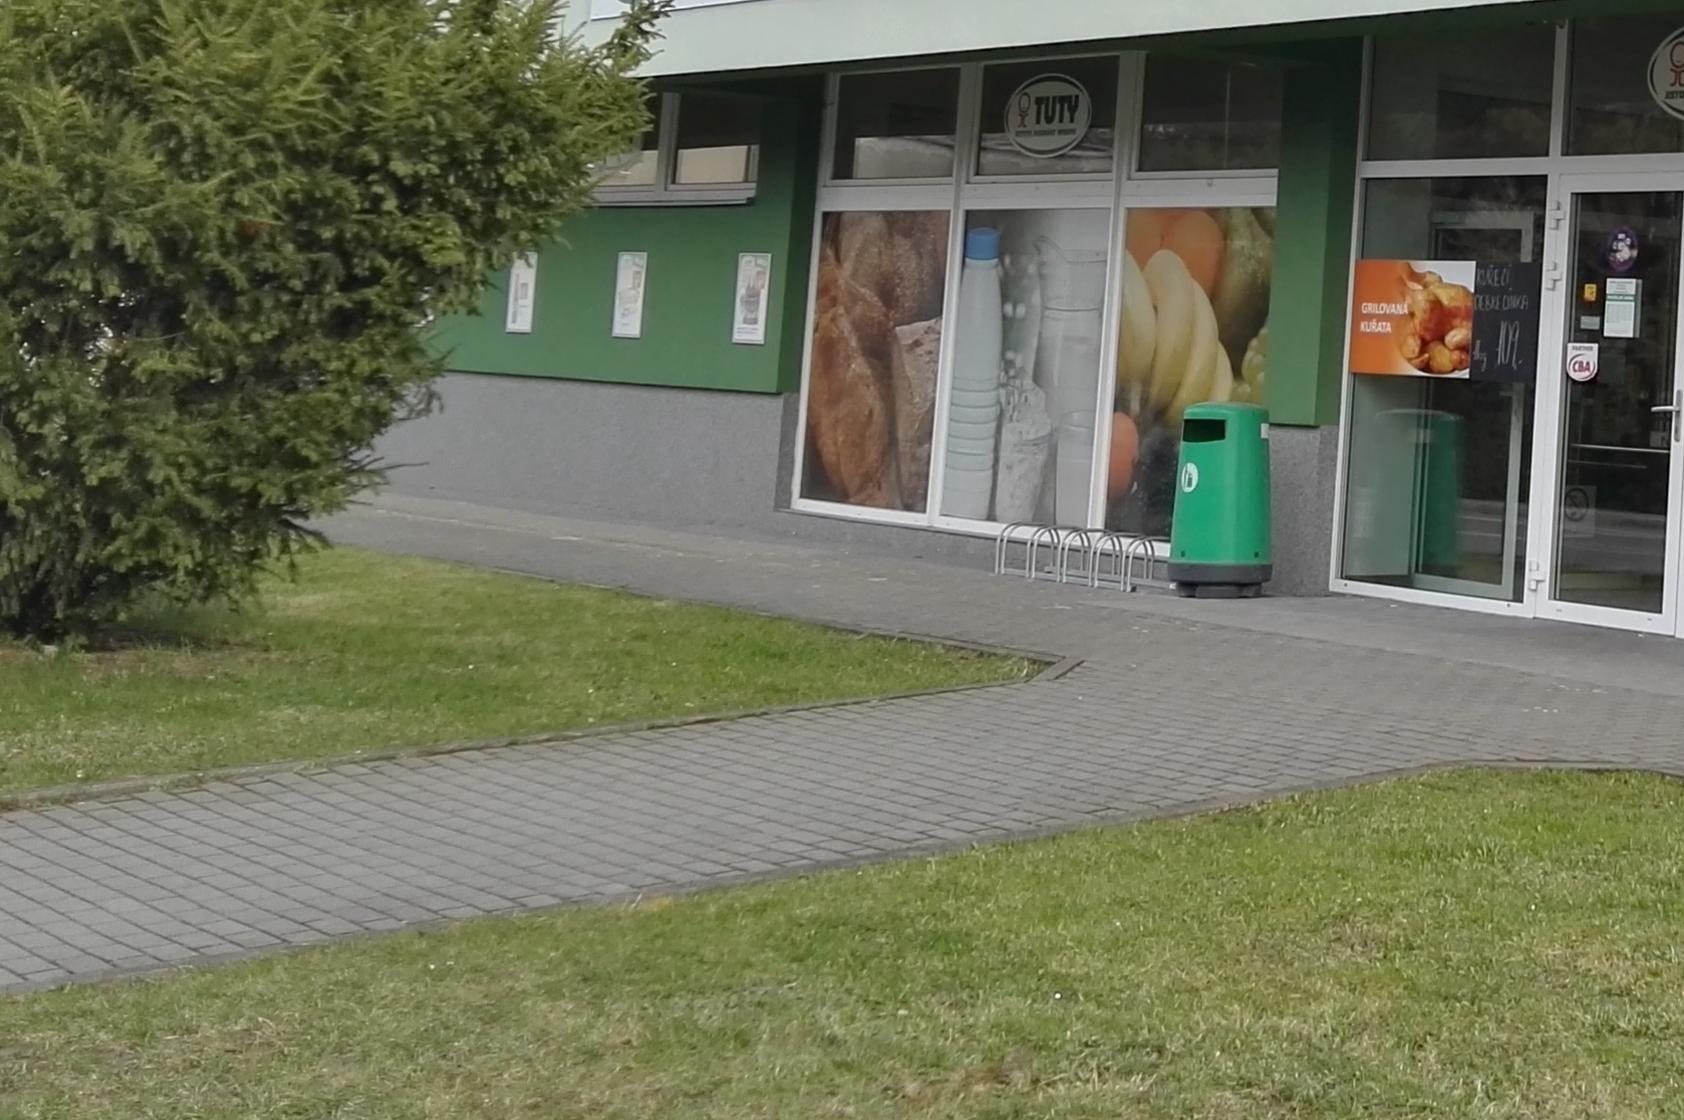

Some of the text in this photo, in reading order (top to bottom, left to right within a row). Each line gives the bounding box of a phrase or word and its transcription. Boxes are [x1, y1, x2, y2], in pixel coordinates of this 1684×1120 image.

[1035, 94, 1080, 125] TUTY
[1361, 301, 1409, 315] GRILOVANÁ
[1359, 320, 1392, 333] KUŘATA
[1572, 360, 1591, 373] CBA
